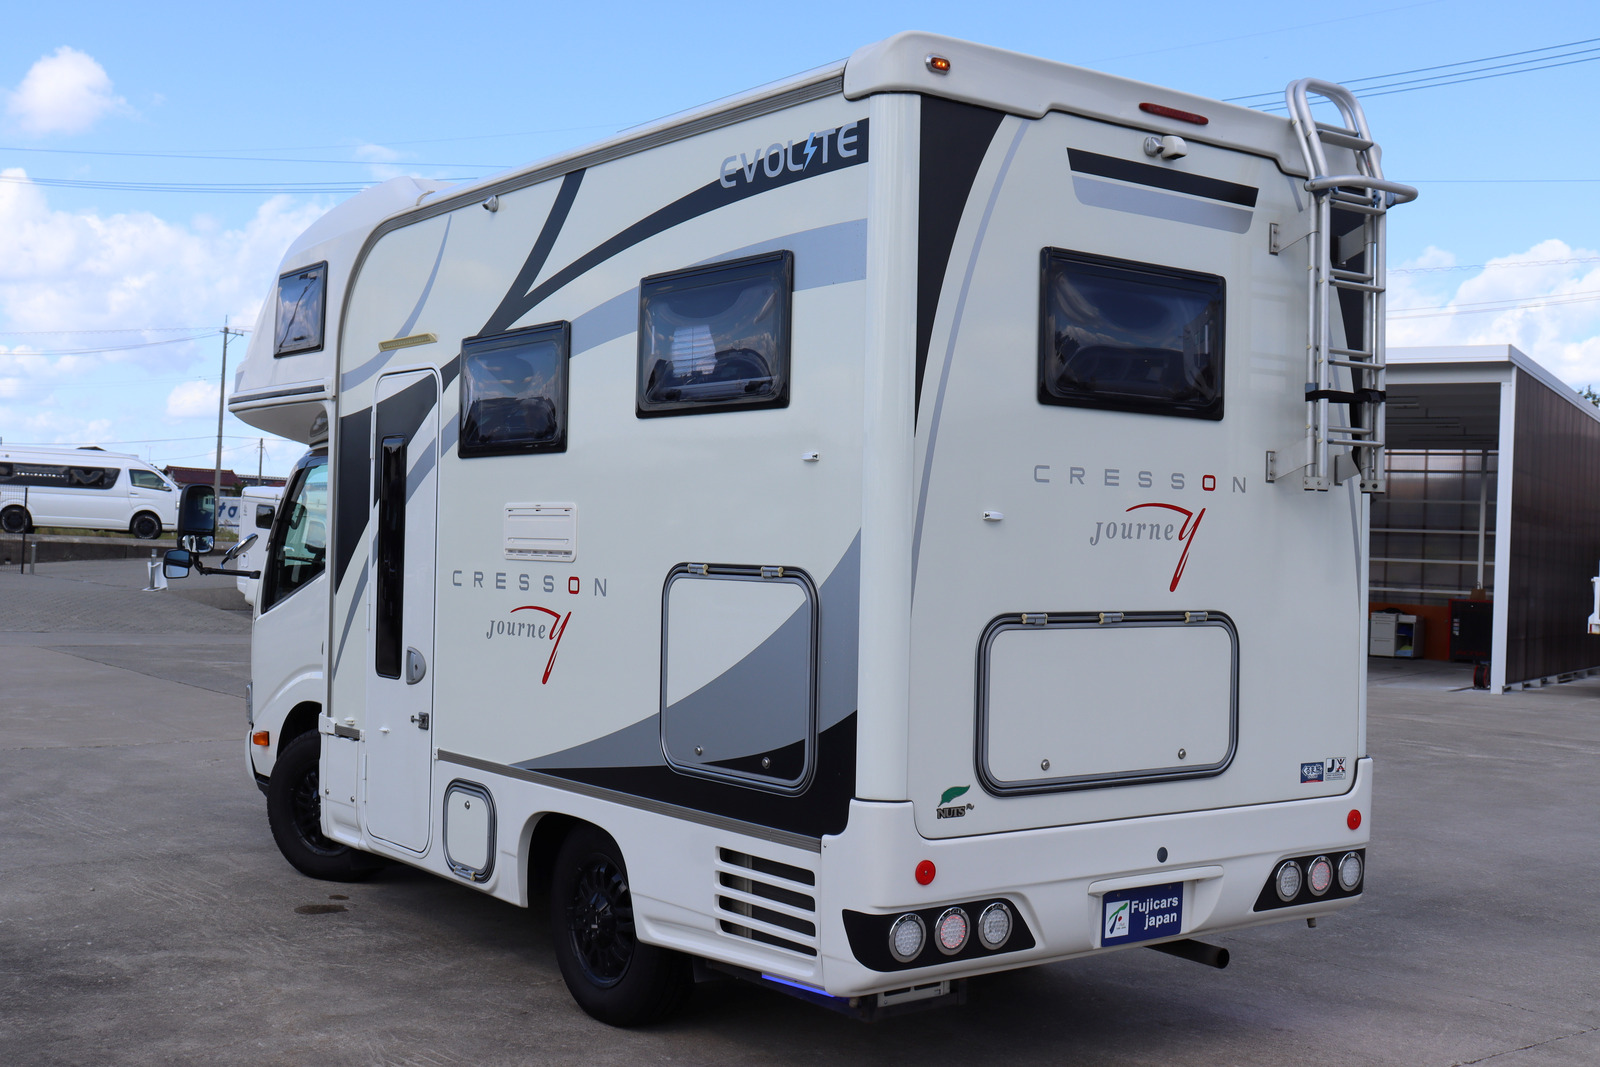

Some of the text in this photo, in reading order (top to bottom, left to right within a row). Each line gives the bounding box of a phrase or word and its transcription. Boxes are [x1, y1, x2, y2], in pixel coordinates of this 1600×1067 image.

[1034, 464, 1246, 494] CRESSON
[452, 569, 607, 597] CRESSON
[936, 806, 966, 820] NUTS
[1131, 896, 1179, 915] Fujicars
[1143, 912, 1178, 931] japan
